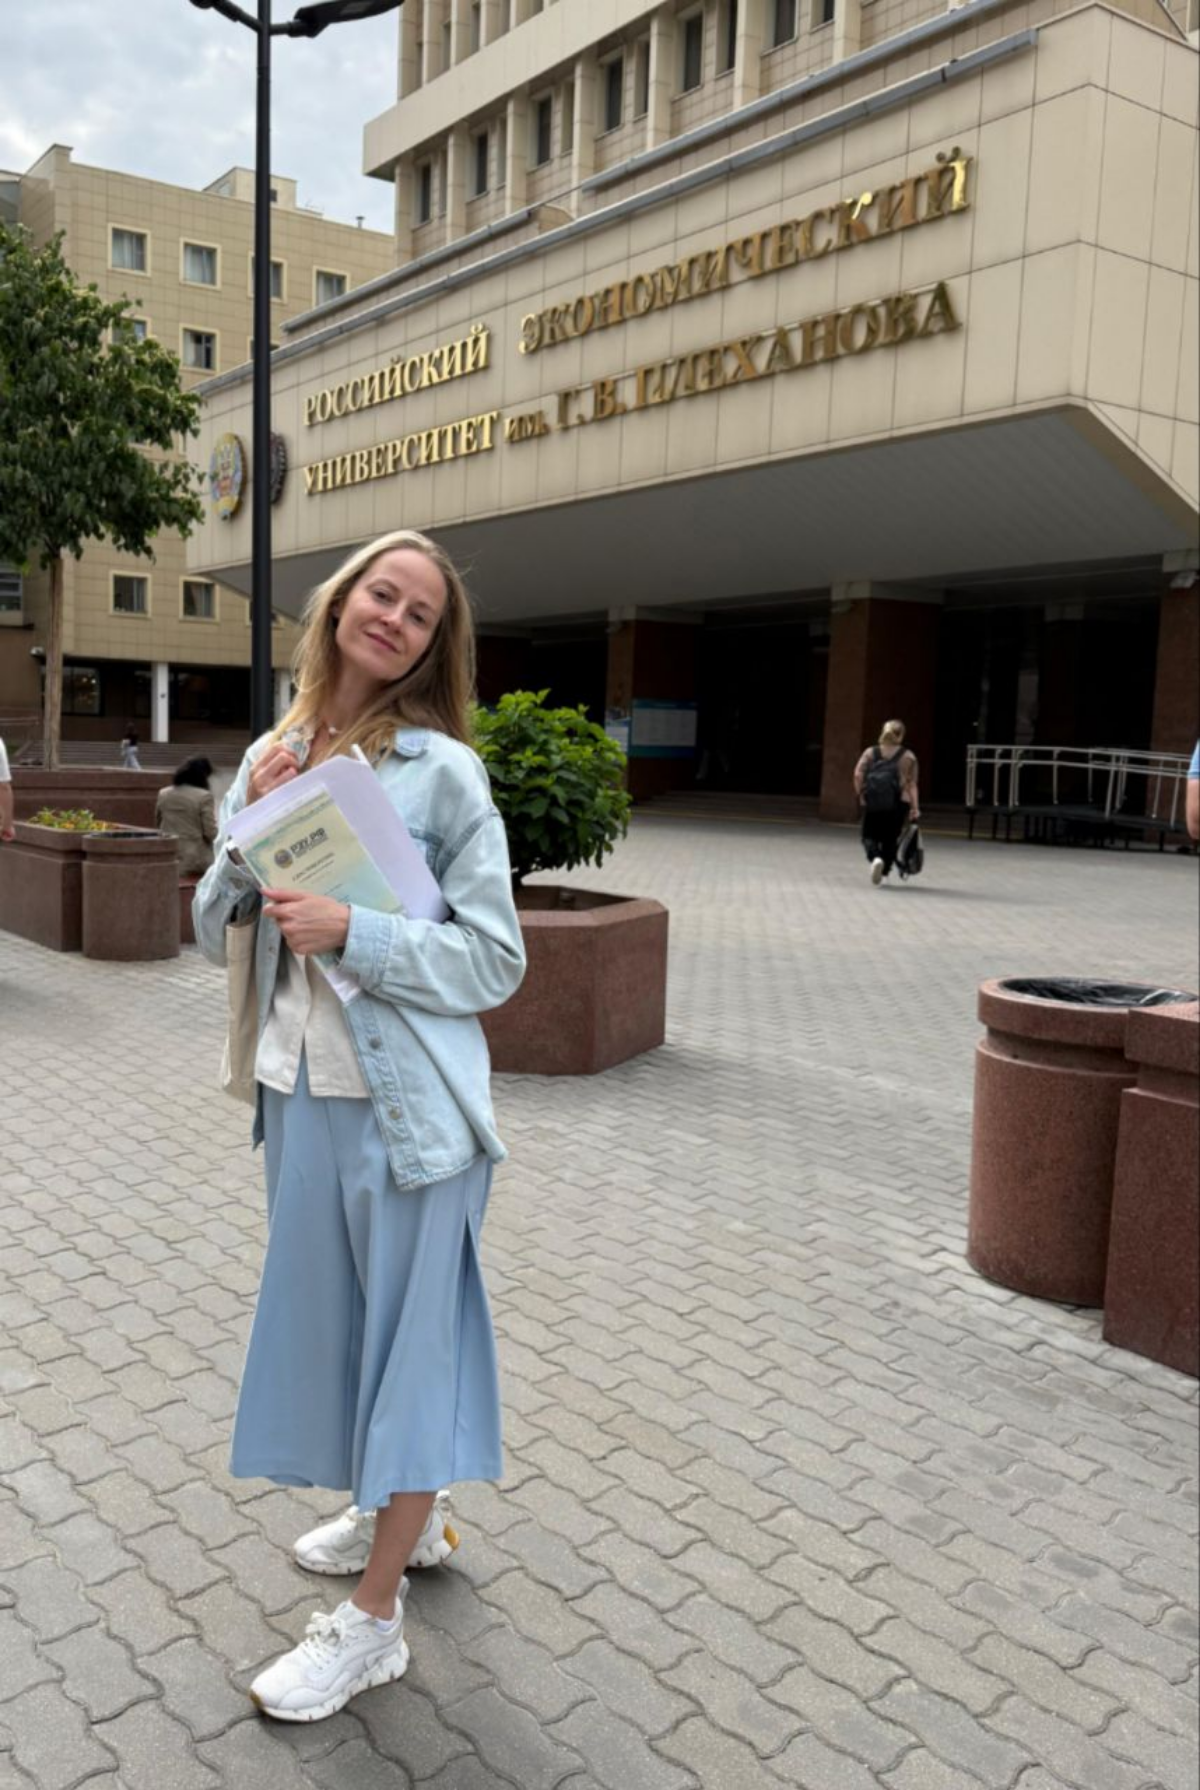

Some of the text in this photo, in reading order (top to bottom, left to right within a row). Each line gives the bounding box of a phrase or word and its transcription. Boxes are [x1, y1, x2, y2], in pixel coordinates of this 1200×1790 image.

[302, 145, 974, 427] РОССИЙСКИЙ ЭКОНОМИЧЕСКИЙ
[302, 410, 499, 495] УНИВЕРСИТЕТ
[633, 281, 963, 411] ПЛЕХАНОВА
